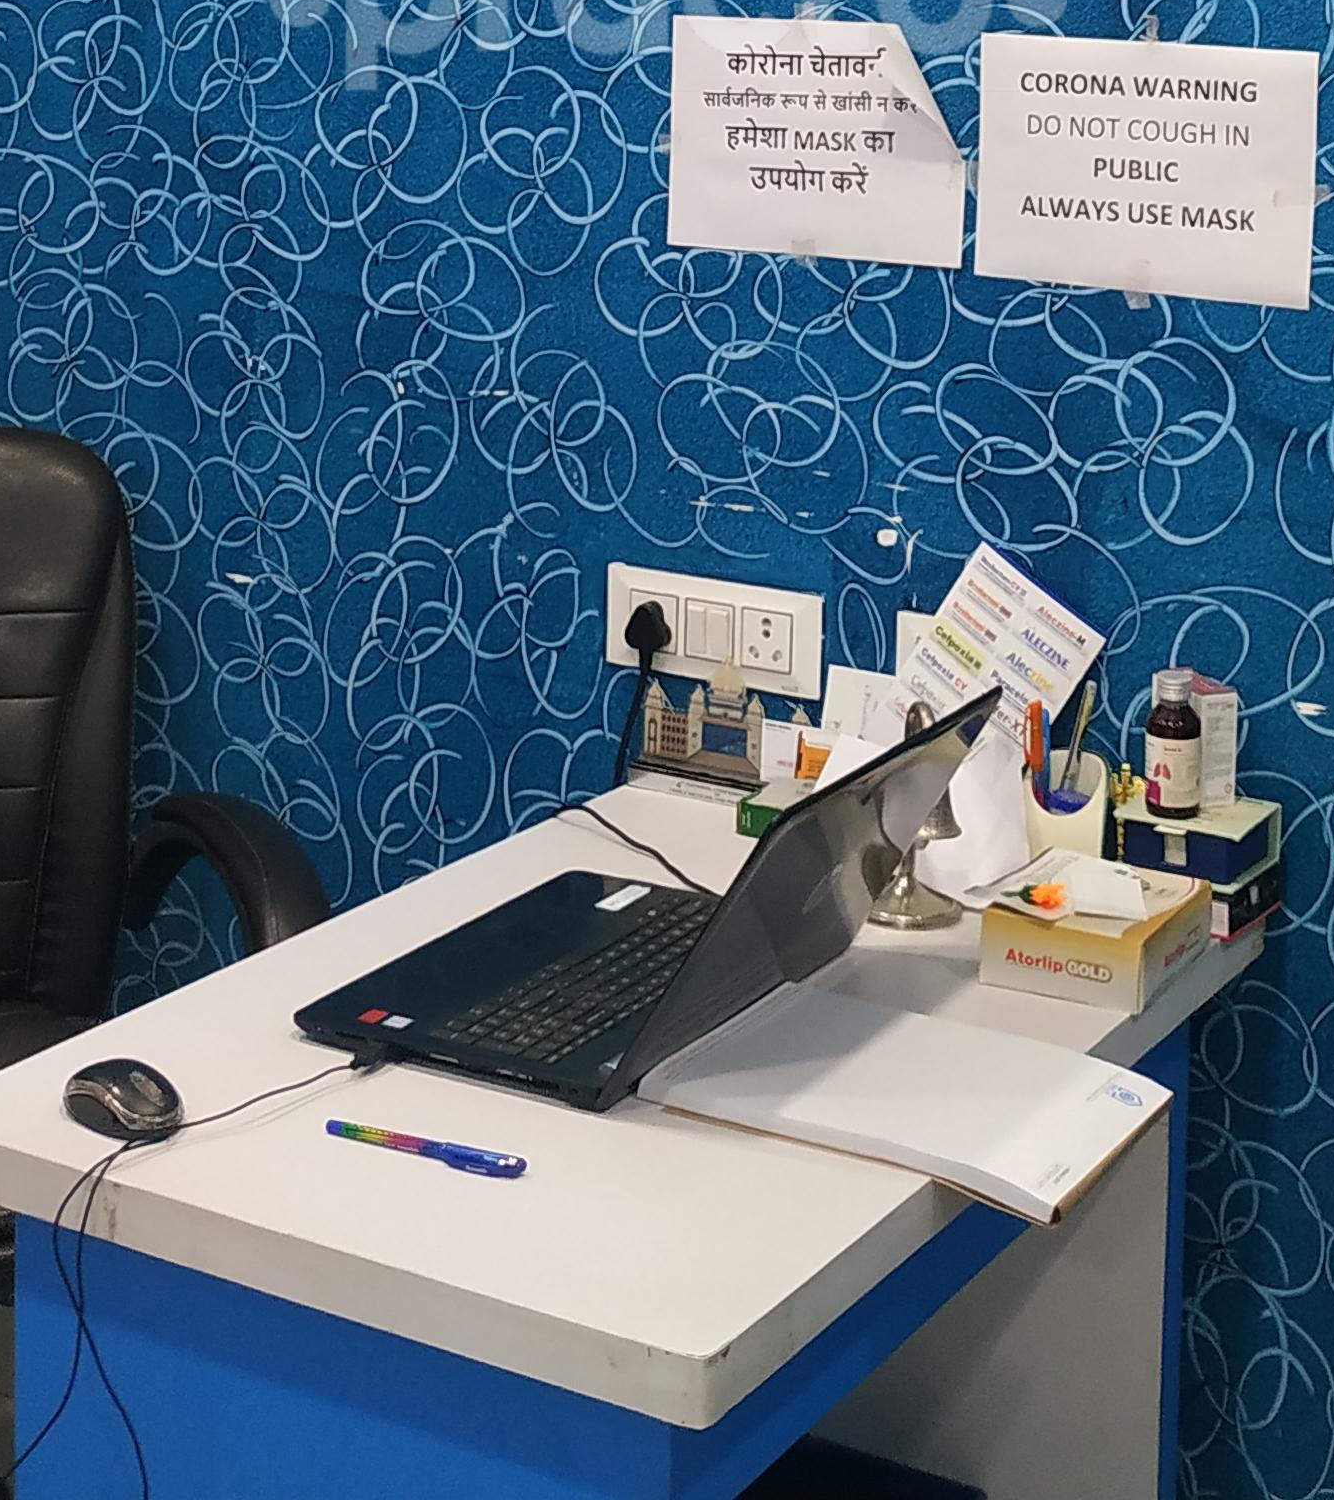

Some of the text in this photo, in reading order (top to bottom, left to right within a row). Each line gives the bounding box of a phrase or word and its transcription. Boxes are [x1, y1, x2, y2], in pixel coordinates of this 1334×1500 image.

[726, 44, 887, 78] कोरोना चेताव
[703, 87, 776, 109] सार्वजनिक
[779, 93, 809, 110] रूप
[813, 89, 827, 110] से
[831, 91, 872, 112] खांसी
[877, 98, 888, 113] न
[1020, 72, 1258, 103] CORONA WARNING
[725, 117, 895, 153] हमेशा MASK का
[1026, 113, 1250, 147] DO NOT COUGH IN
[749, 160, 869, 195] उपयोग करें
[1094, 158, 1179, 182] PUBLIC
[1020, 195, 1256, 232] ALWAYS USE MASK
[1022, 628, 1071, 671] ALECZINE
[1005, 652, 1055, 693] Aleczine
[1005, 948, 1111, 982] Atorlip GOLD
